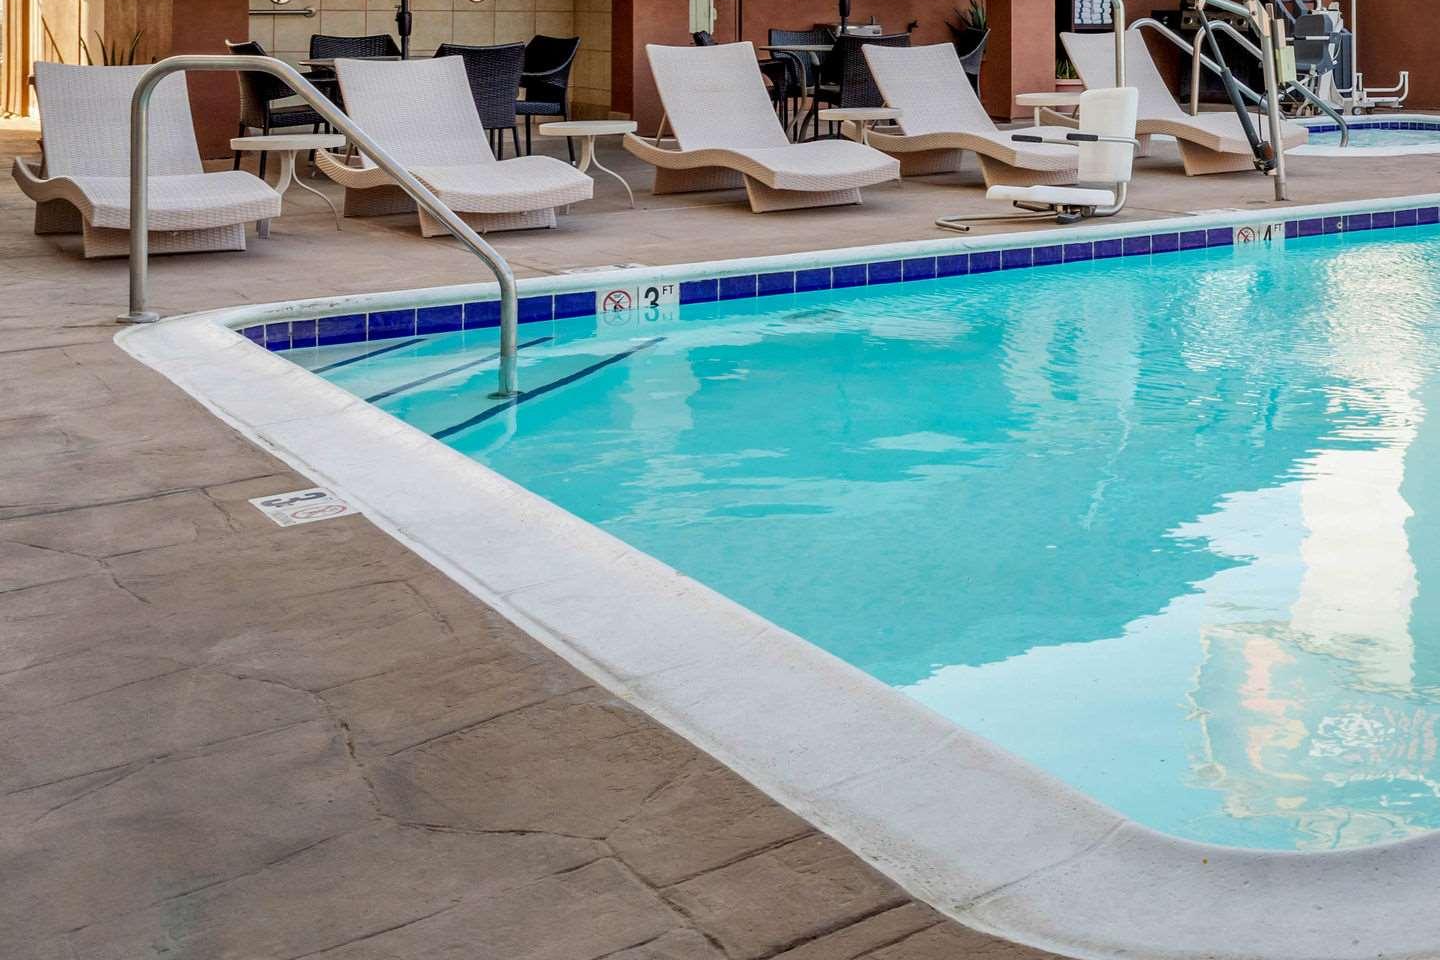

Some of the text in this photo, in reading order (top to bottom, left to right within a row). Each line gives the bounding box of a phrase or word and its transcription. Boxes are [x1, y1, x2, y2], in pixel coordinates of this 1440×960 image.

[1274, 224, 1282, 232] FT
[644, 284, 674, 309] 3 FT
